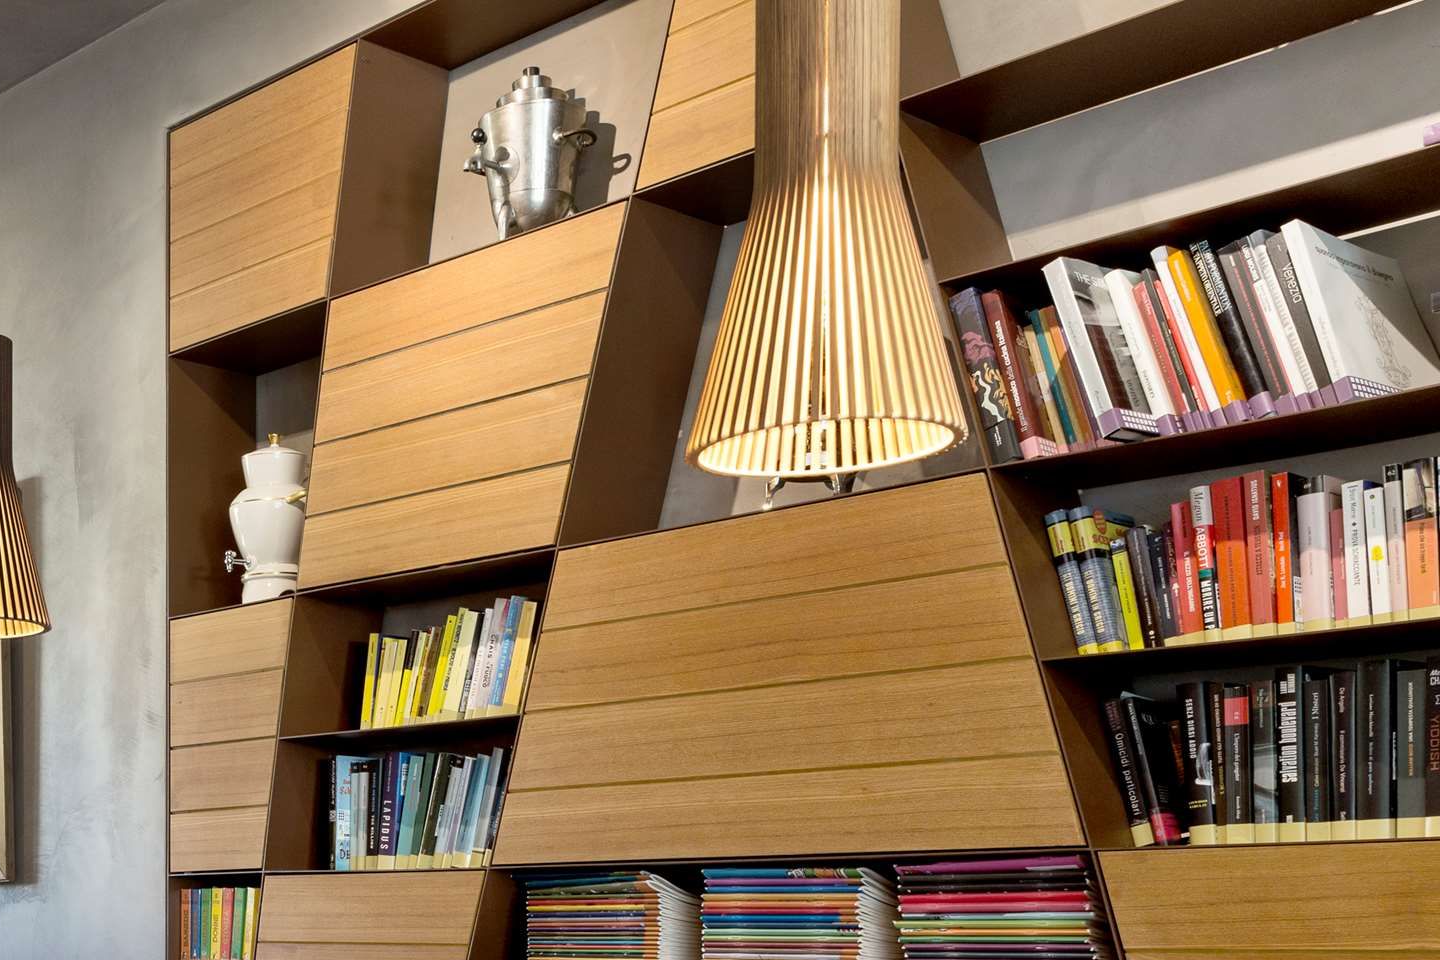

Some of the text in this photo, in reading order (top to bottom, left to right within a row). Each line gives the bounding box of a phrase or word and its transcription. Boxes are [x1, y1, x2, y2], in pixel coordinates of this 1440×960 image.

[1073, 271, 1093, 287] THE
[1282, 262, 1303, 304] Venezia
[1204, 279, 1222, 317] ORIENTALE
[992, 319, 1006, 346] italiana
[999, 344, 1011, 366] cucina
[1004, 365, 1015, 380] della
[1007, 379, 1022, 407] mosaico
[1249, 479, 1259, 520] DAVID IGNATIUS
[1192, 490, 1209, 568] Megan ABBOTT
[1065, 580, 1079, 605] UOMINI
[1085, 578, 1098, 603] UOMINI
[1201, 579, 1214, 611] MORIRE
[1203, 611, 1215, 623] UN
[1311, 691, 1320, 714] Misteri
[1338, 687, 1345, 695] De
[1184, 698, 1193, 718] SENZA
[1186, 719, 1195, 738] DIRSI
[1278, 700, 1298, 782] salvation boulevard
[1113, 732, 1130, 767] Omicidi
[1429, 715, 1440, 771] YIDDISH
[1121, 769, 1142, 816] particolari
[379, 799, 391, 850] LAPIDUS
